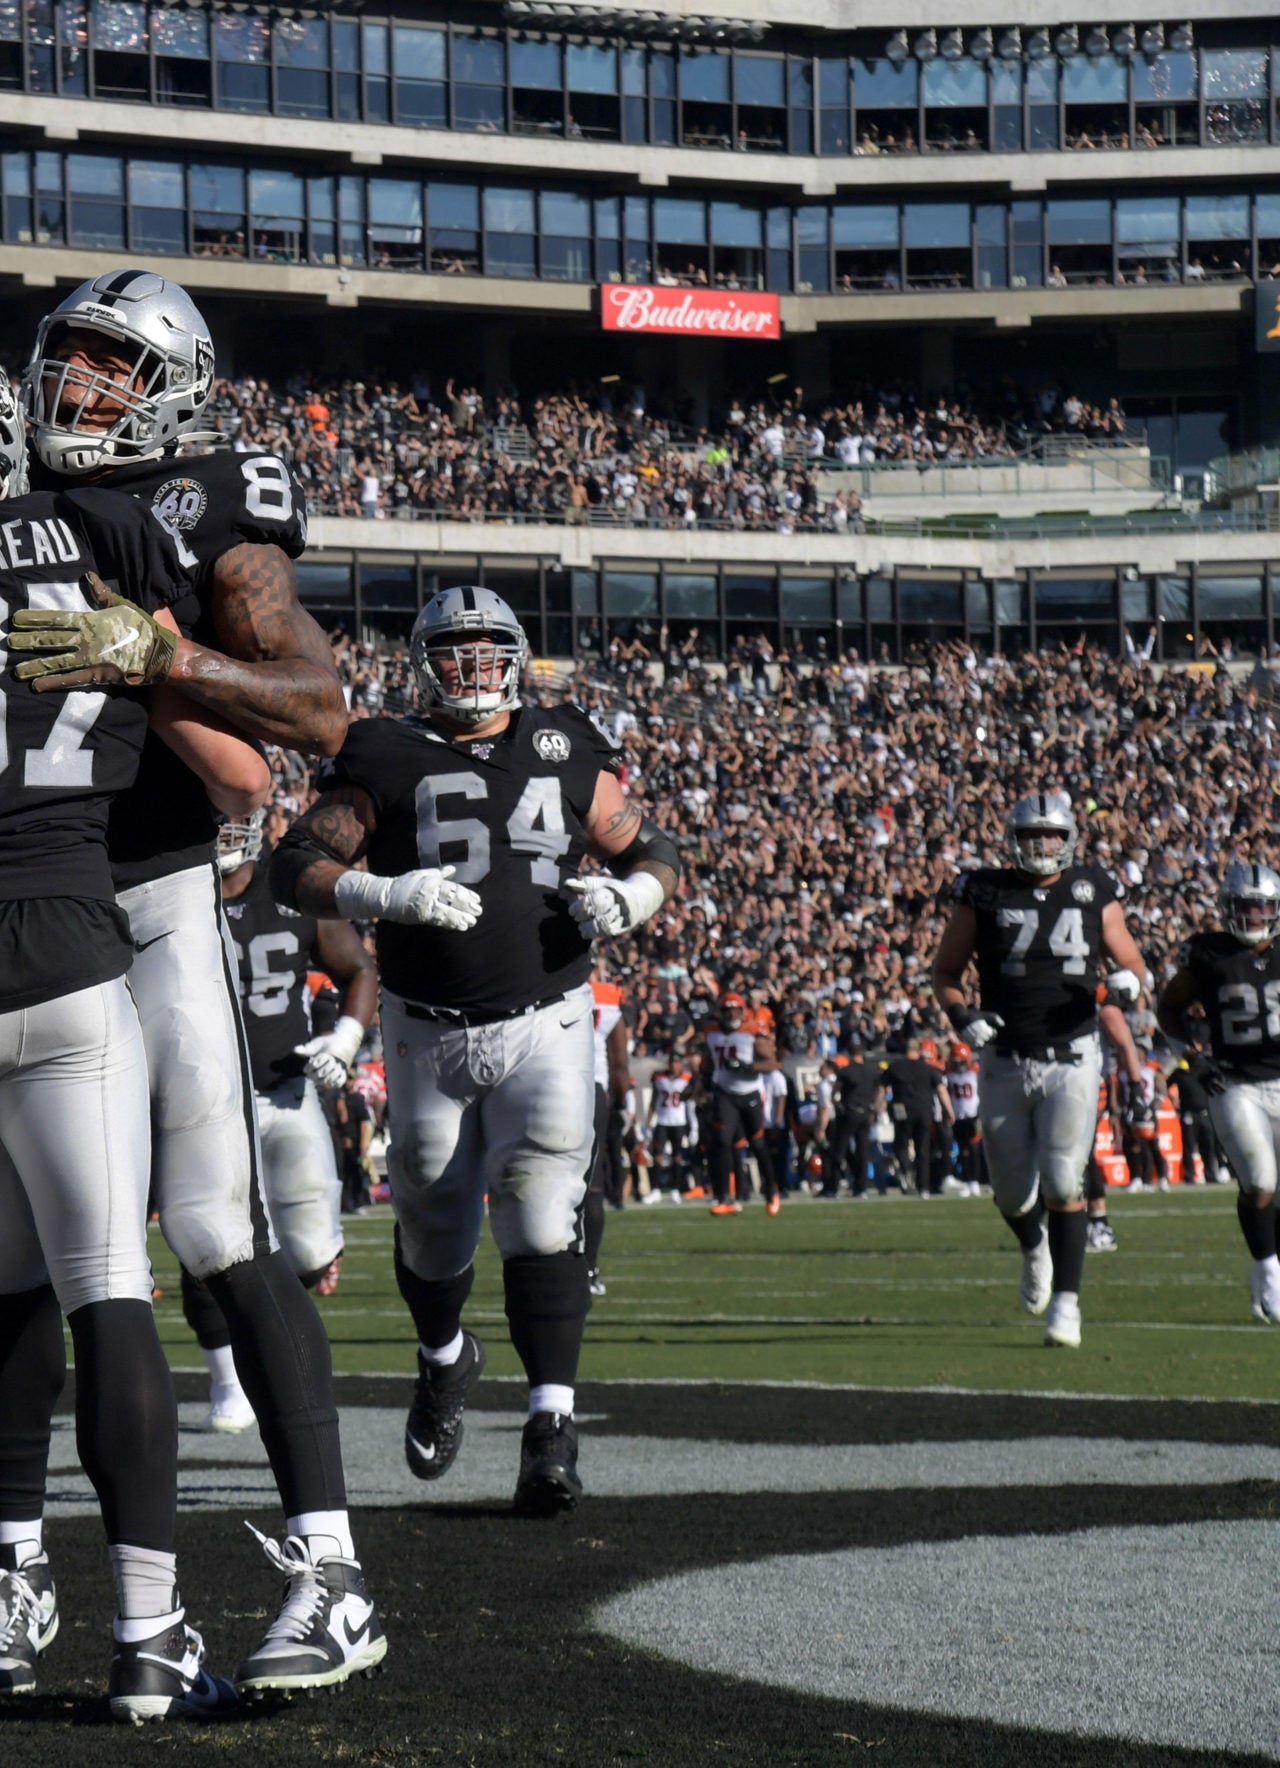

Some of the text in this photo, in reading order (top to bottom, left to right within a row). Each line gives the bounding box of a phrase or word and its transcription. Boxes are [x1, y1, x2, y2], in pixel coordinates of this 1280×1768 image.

[609, 287, 773, 332] Budweiser
[160, 490, 200, 517] 60
[539, 735, 566, 751] 60
[415, 771, 571, 889] 64
[997, 907, 1090, 976] 74
[233, 931, 299, 1017] 6
